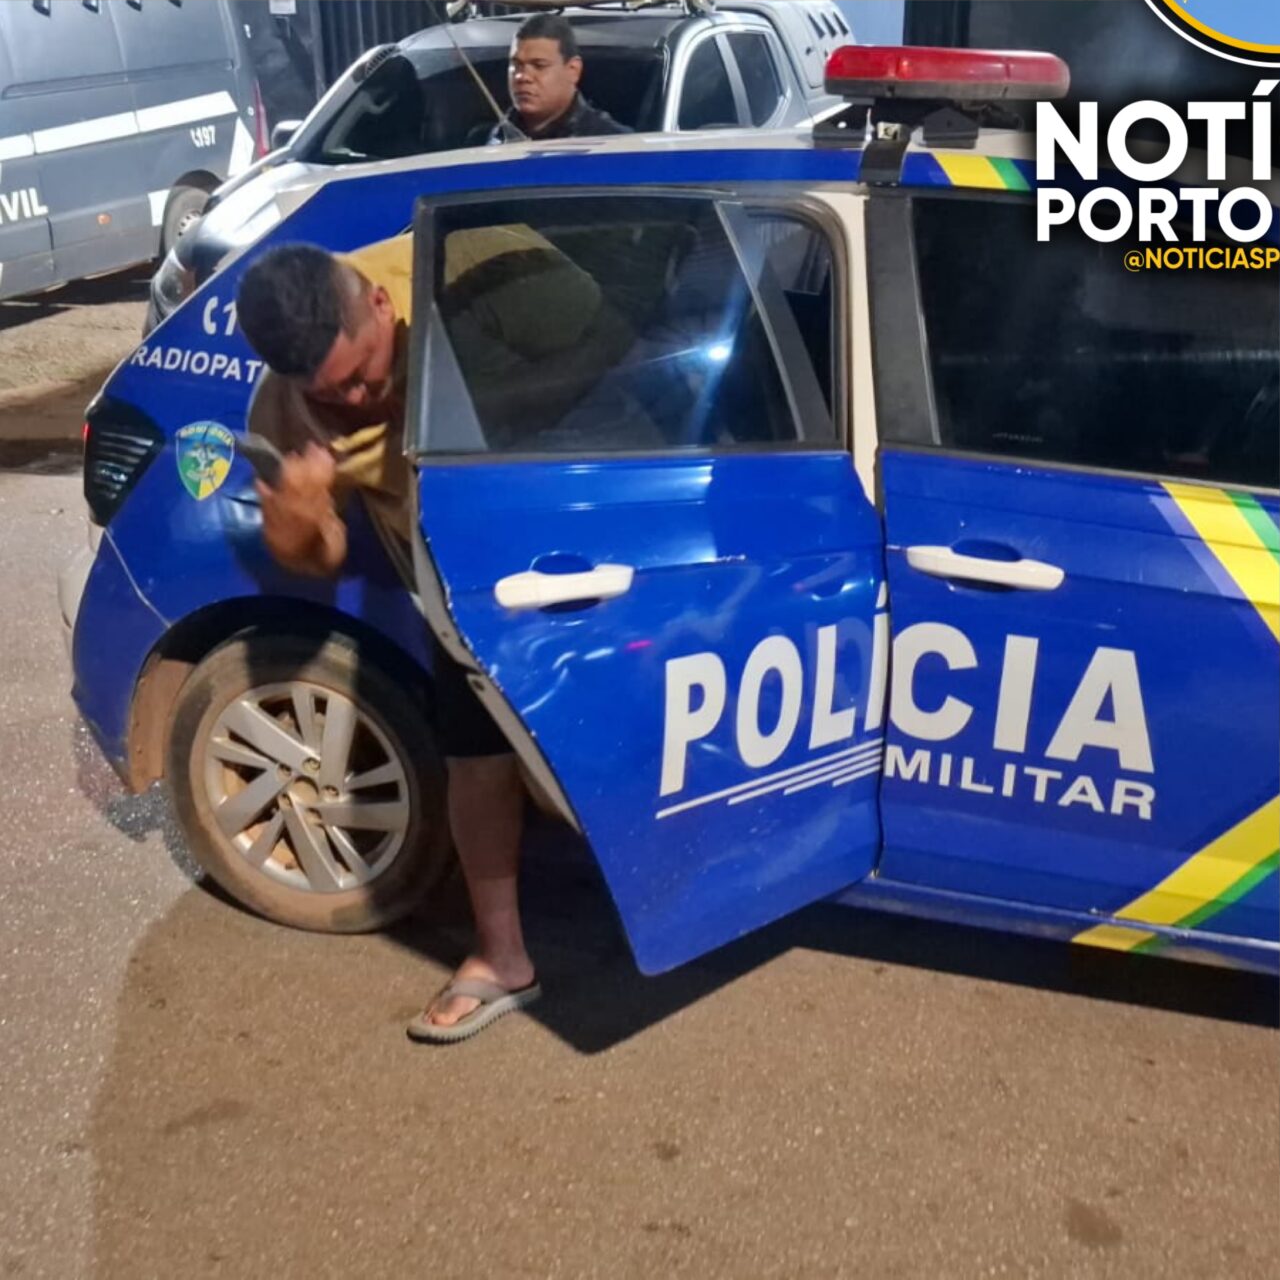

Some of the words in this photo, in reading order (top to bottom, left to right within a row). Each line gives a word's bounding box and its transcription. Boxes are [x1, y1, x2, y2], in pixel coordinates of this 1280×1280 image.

[0, 188, 48, 221] VIL
[131, 346, 262, 384] RADIOPAT
[660, 580, 1155, 797] POLÍCIA
[885, 745, 1156, 821] MILITAR
